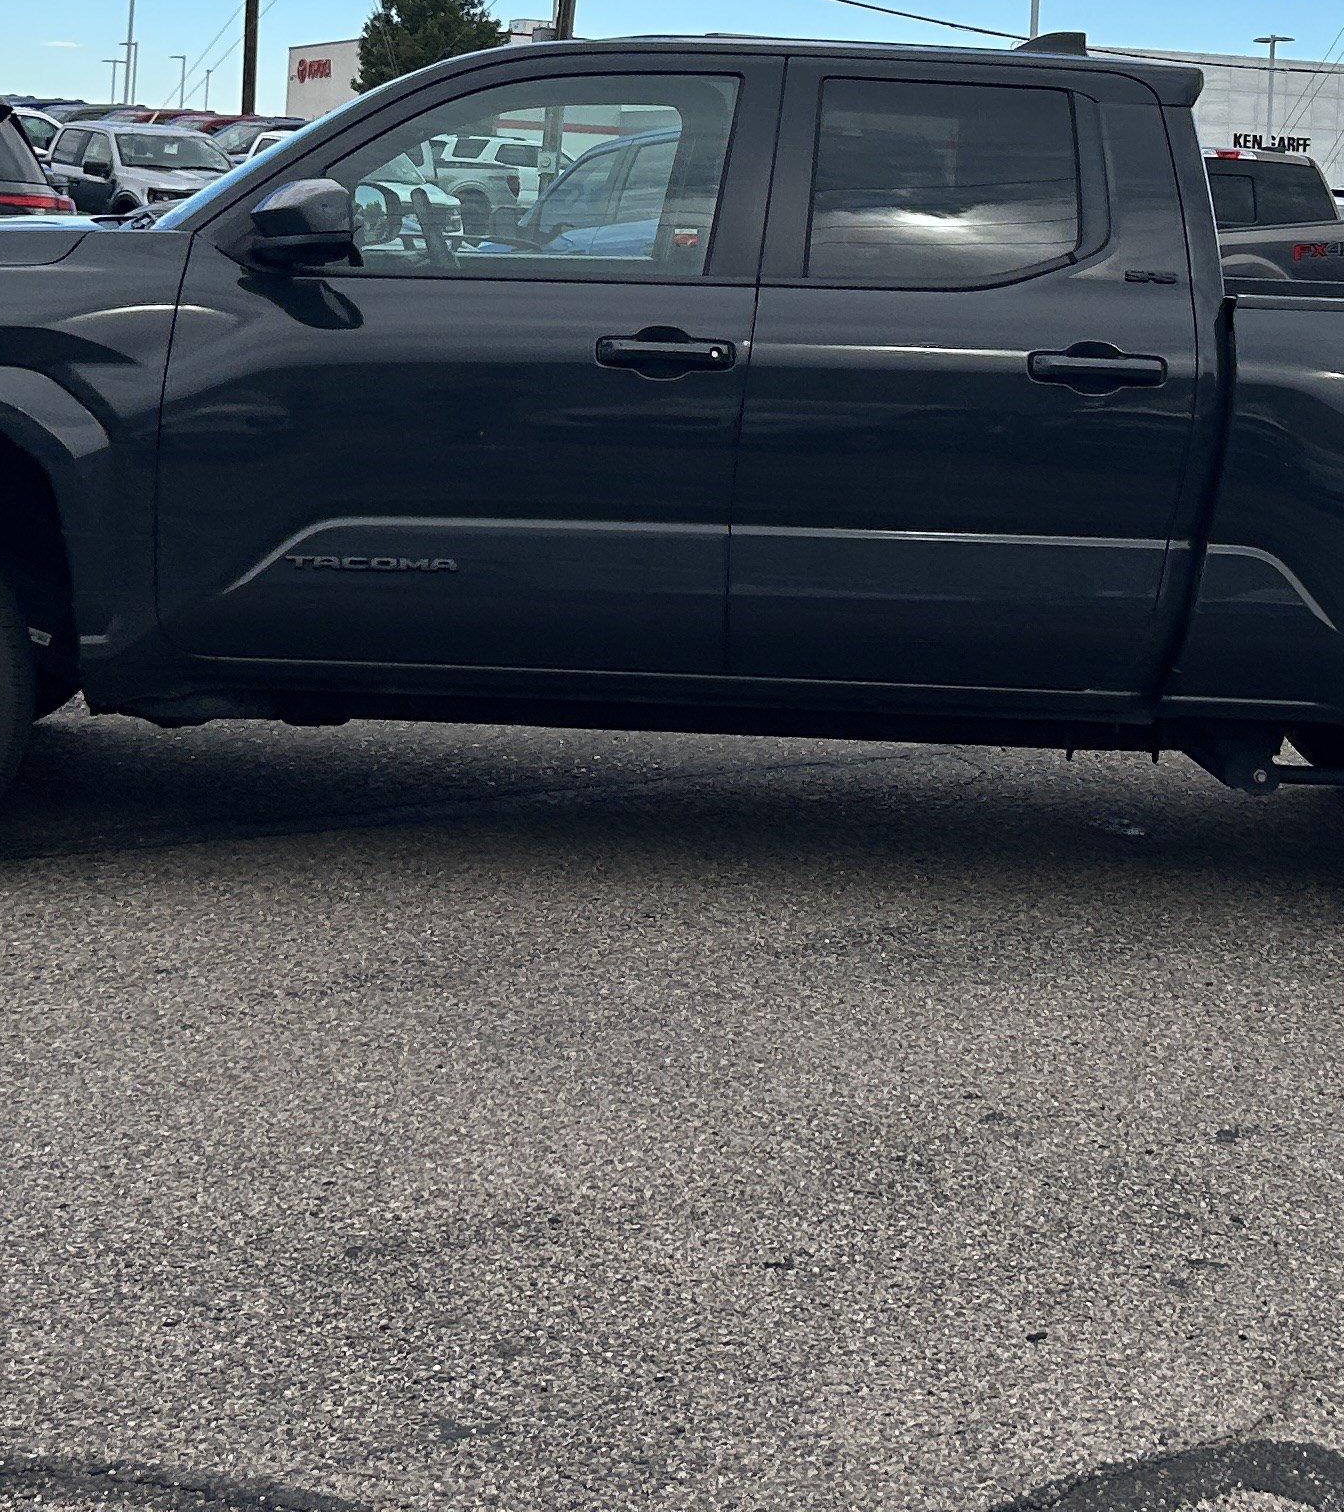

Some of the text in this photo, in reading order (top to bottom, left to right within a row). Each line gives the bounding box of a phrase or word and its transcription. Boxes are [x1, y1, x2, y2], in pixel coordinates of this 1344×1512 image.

[1233, 133, 1263, 150] KEN
[1293, 241, 1344, 262] FX4
[285, 555, 459, 573] TACOMA
